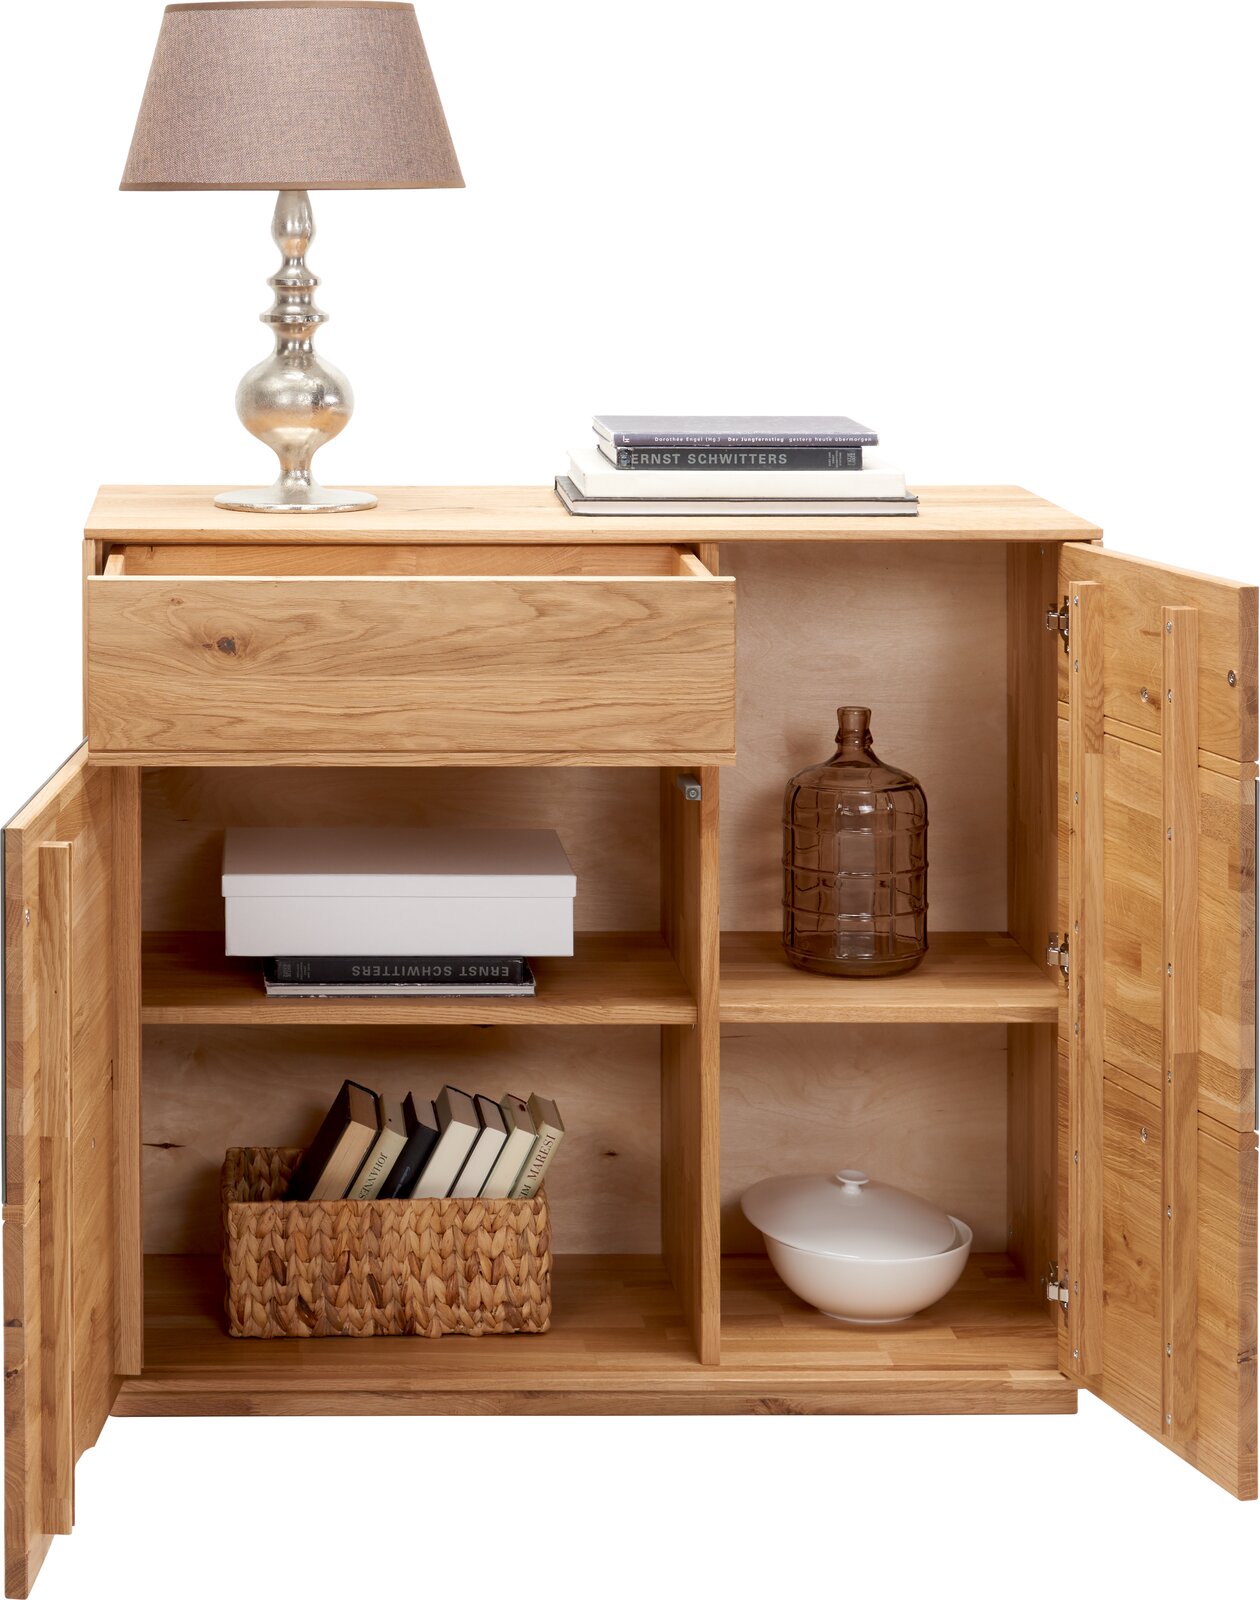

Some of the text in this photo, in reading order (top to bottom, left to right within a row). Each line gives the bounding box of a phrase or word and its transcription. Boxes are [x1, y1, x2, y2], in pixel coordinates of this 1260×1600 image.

[631, 453, 788, 465] ERNST SCHWITTERS
[351, 965, 509, 977] ERNST SCHWITTERS
[359, 1152, 388, 1199] JOHANNES
[519, 1134, 556, 1199] IM MARESI
